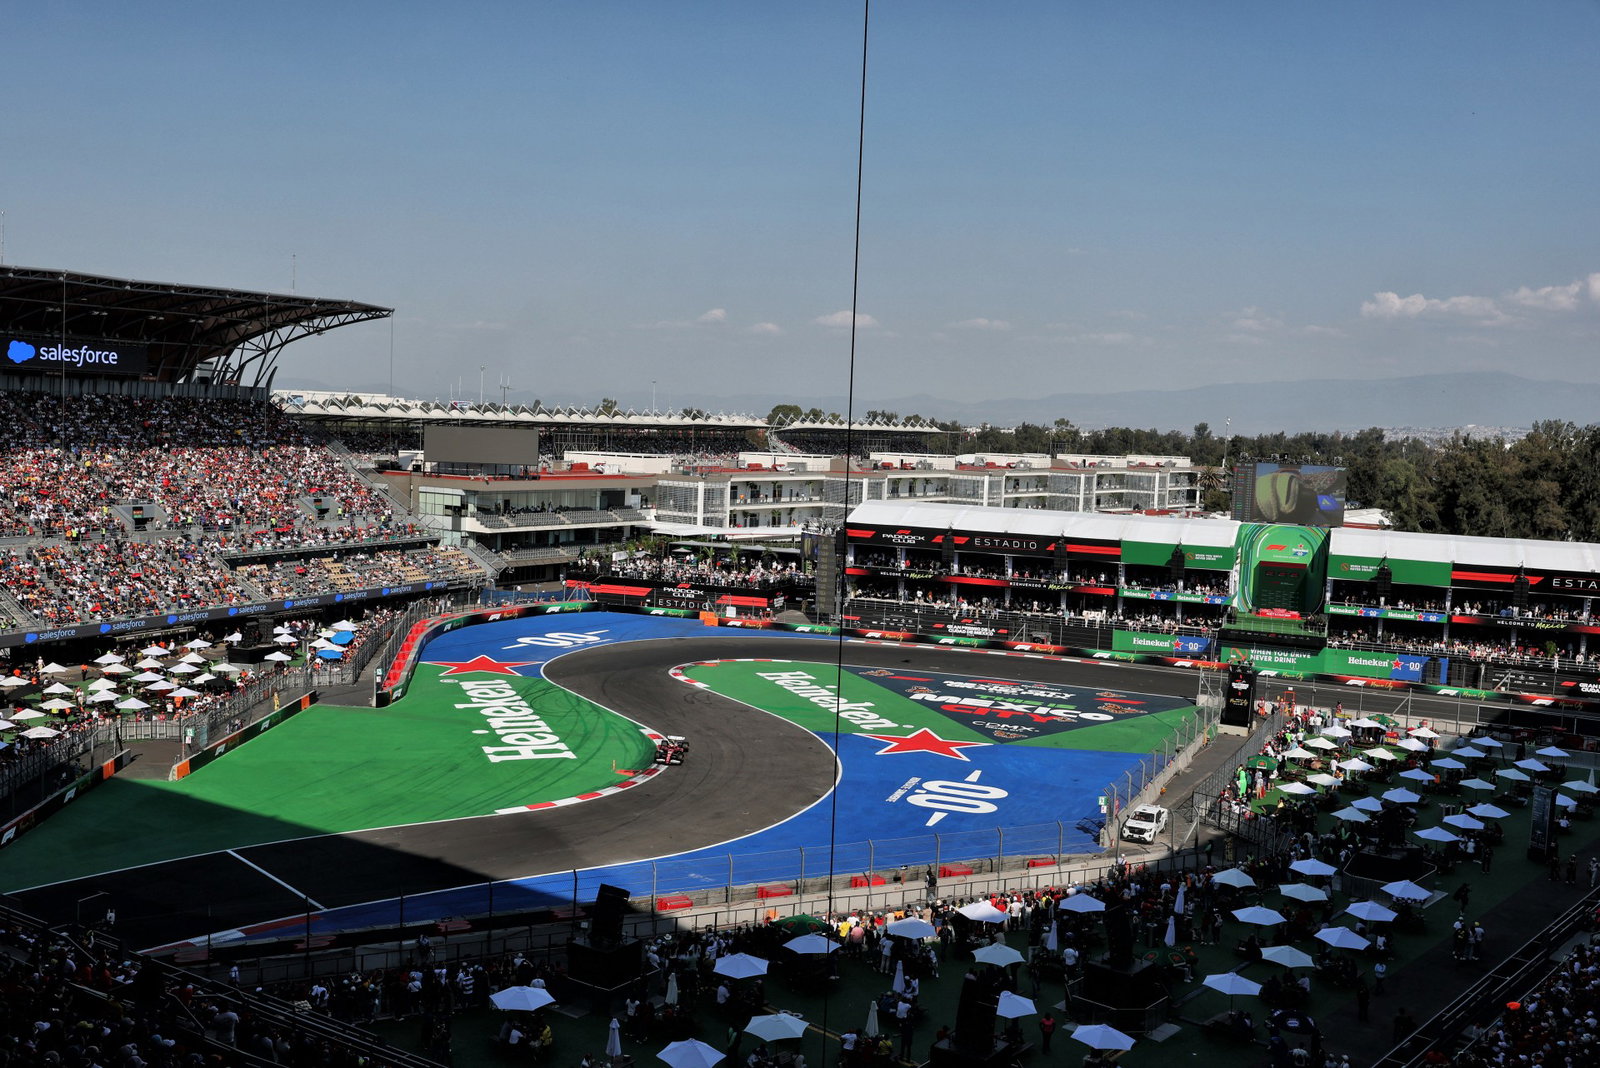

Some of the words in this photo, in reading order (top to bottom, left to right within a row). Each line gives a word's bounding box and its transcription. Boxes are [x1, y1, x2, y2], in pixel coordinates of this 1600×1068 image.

[39, 344, 118, 367] salesforce
[974, 538, 1037, 550] ESTADIO
[1552, 579, 1598, 589] ESTA
[344, 591, 368, 600] salesforce
[390, 586, 412, 594] salesforce
[294, 597, 319, 607] salesforce
[238, 604, 267, 614] salesforce
[179, 611, 209, 622] salesforce
[112, 620, 146, 630] salesforce
[39, 628, 76, 640] salesforce
[1133, 637, 1168, 647] Heineken
[1348, 657, 1388, 667] Heineken
[756, 670, 885, 730] Heineken
[976, 694, 1044, 706] THIS
[909, 693, 1114, 721] MEXICO
[940, 704, 1061, 723] CITY
[454, 679, 577, 762] Heineken
[972, 720, 1034, 732] CDMX
